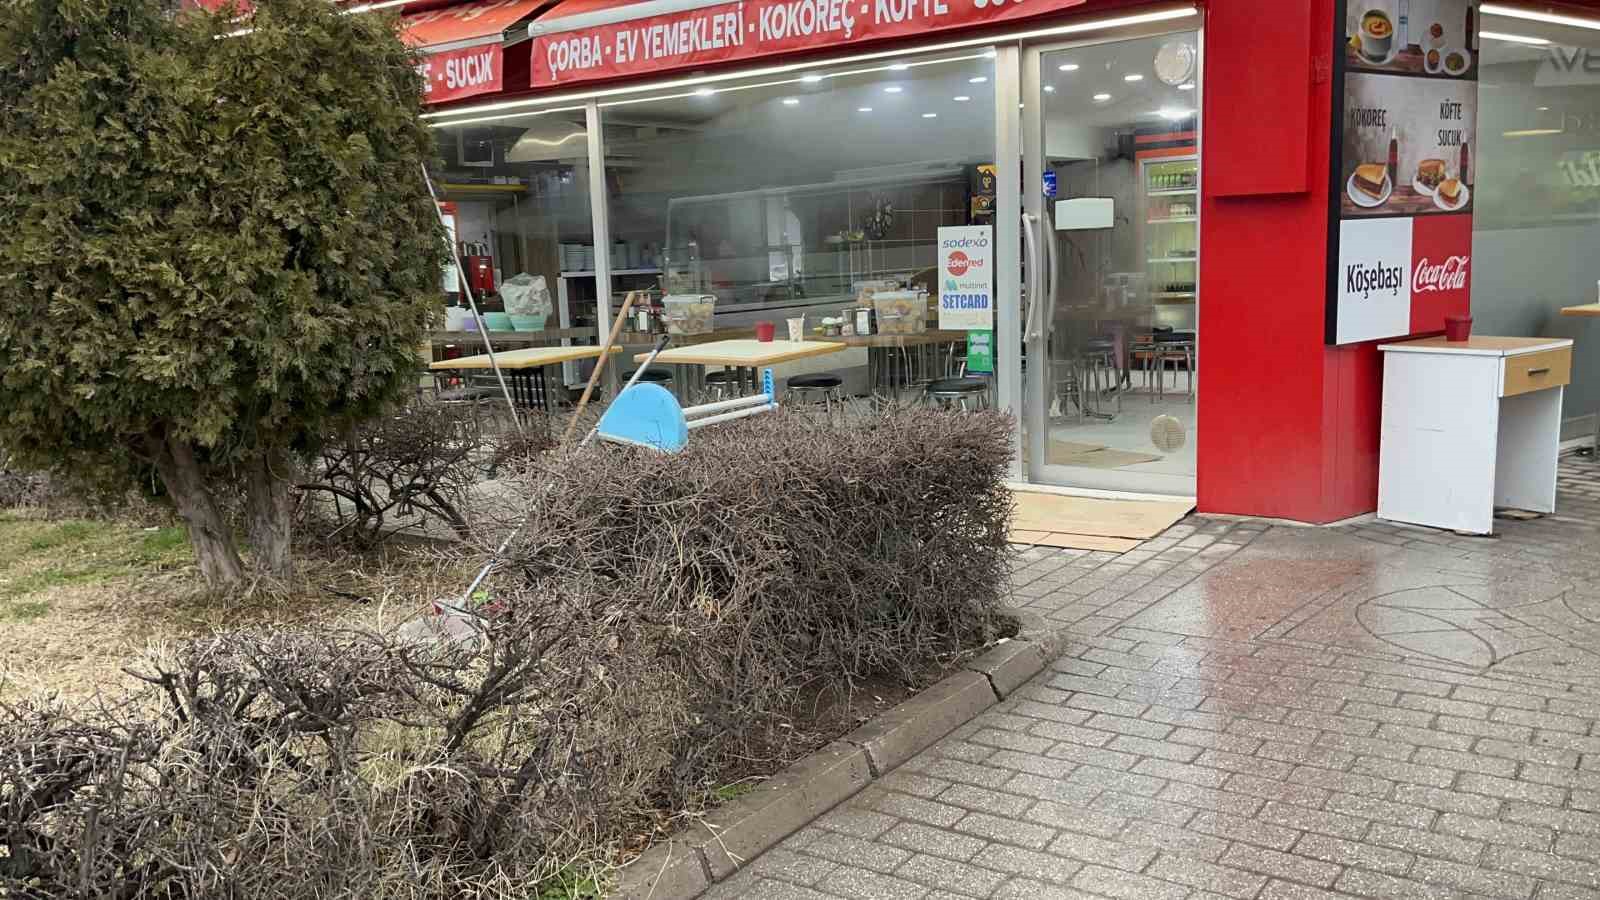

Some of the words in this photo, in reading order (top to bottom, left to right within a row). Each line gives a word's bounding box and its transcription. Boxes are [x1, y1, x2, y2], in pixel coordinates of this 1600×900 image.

[547, 36, 604, 81] ÇORBA
[614, 30, 639, 63] EV
[641, 3, 744, 60] YEMEKLERİ
[759, 0, 854, 41] KOKOREÇ
[446, 51, 494, 89] SUCUK
[1350, 108, 1387, 132] KOKOREÇ
[1440, 98, 1462, 120] KÖFTE
[1438, 129, 1462, 146] SUCUK
[942, 233, 988, 249] sodexo
[1347, 261, 1403, 299] Köşebaşı
[1412, 255, 1470, 293] Coca-Cola
[943, 294, 988, 309] SETCARD
